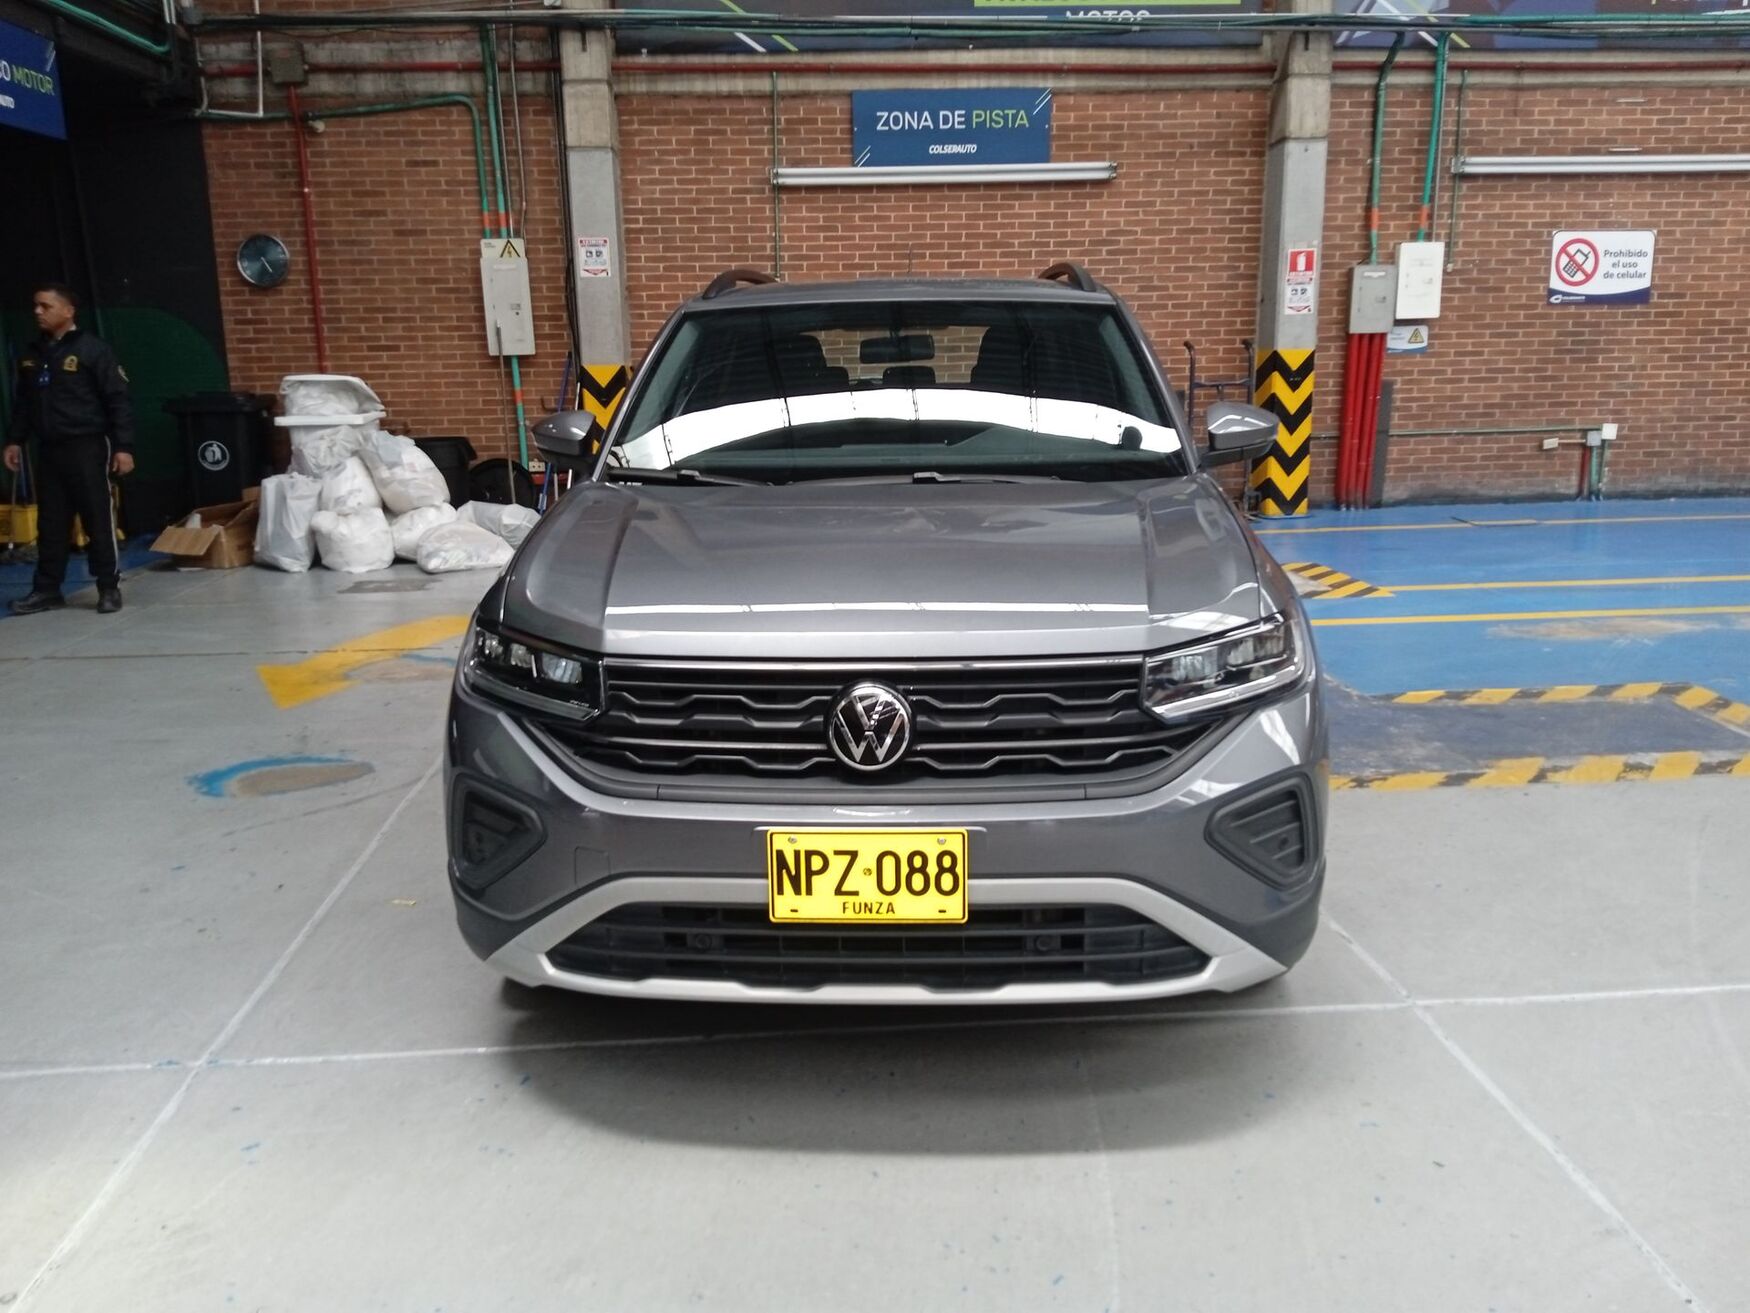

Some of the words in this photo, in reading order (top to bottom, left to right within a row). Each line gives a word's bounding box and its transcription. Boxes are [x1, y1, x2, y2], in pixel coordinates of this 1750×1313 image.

[12, 64, 55, 95] MOTOR
[876, 110, 934, 131] ZONA
[939, 110, 966, 129] DE
[972, 109, 1030, 129] PISTA
[929, 144, 977, 155] COLSERAUTO
[1603, 249, 1648, 258] Prohibido
[1612, 261, 1621, 269] el
[1603, 271, 1614, 279] de
[1616, 270, 1647, 279] celular
[775, 849, 860, 897] NPZ
[875, 849, 960, 897] 088
[842, 901, 896, 915] FUNZA
